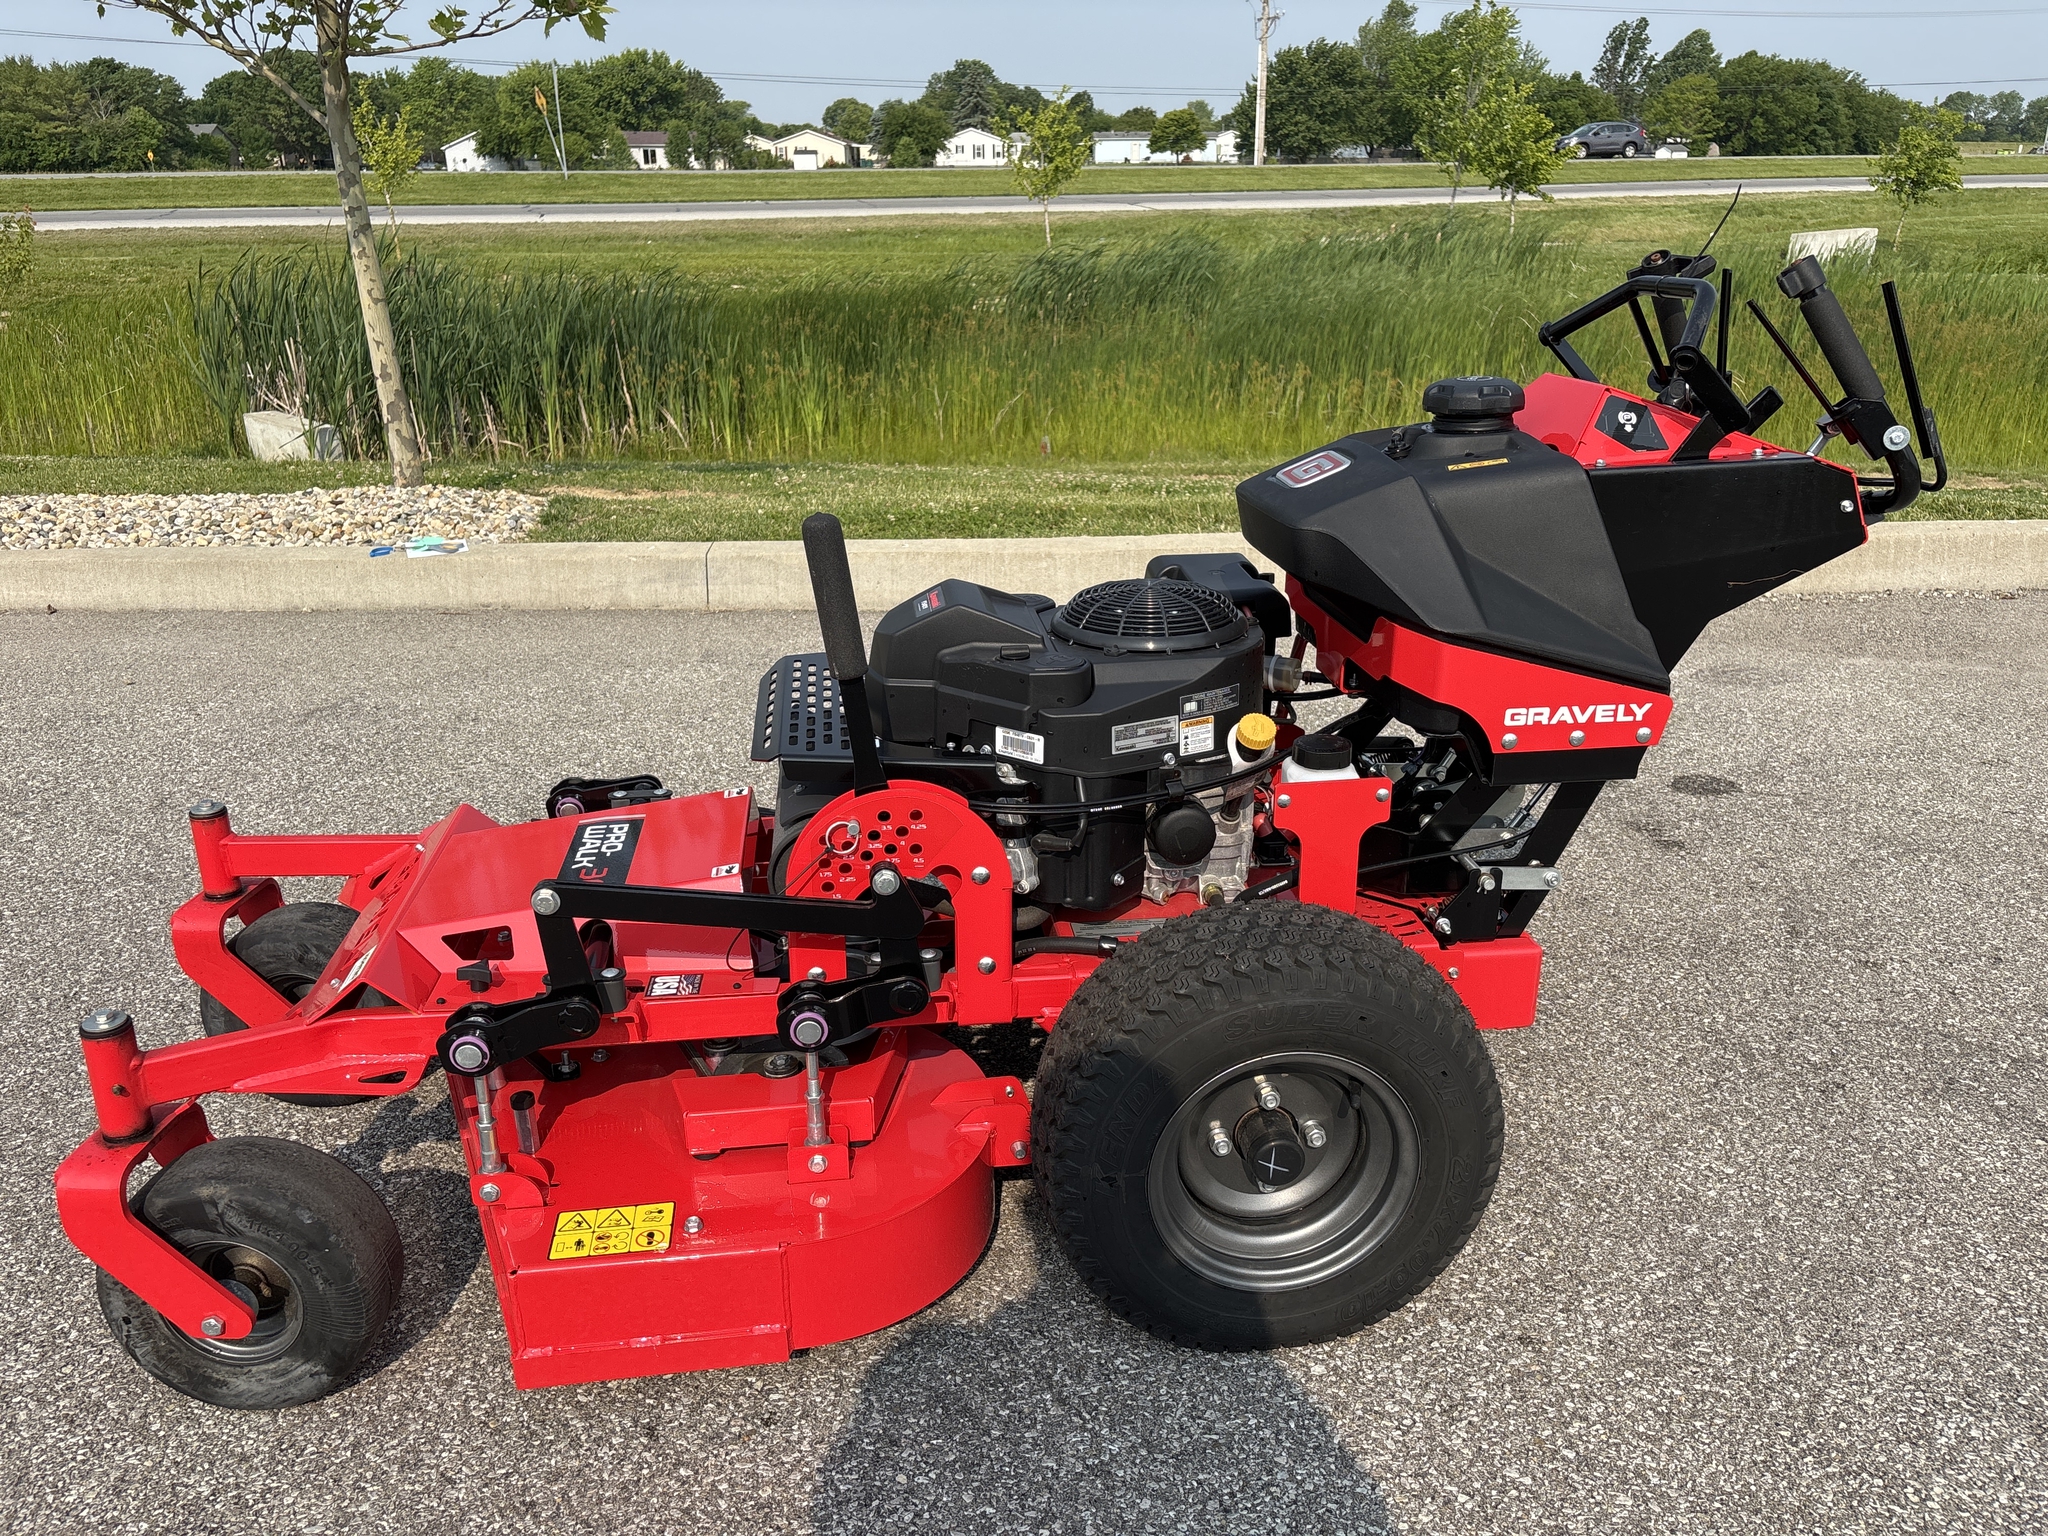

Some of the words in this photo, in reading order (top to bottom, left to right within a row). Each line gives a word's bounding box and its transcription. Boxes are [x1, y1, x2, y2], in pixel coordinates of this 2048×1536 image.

[1503, 702, 1653, 727] GRAVELY
[571, 825, 607, 869] WALK
[600, 824, 630, 857] PRO-
[579, 867, 609, 883] 3
[651, 975, 681, 996] USA
[1223, 1004, 1378, 1042] SUPER
[1388, 1025, 1468, 1108] TURF
[1091, 1060, 1178, 1198] KENDA
